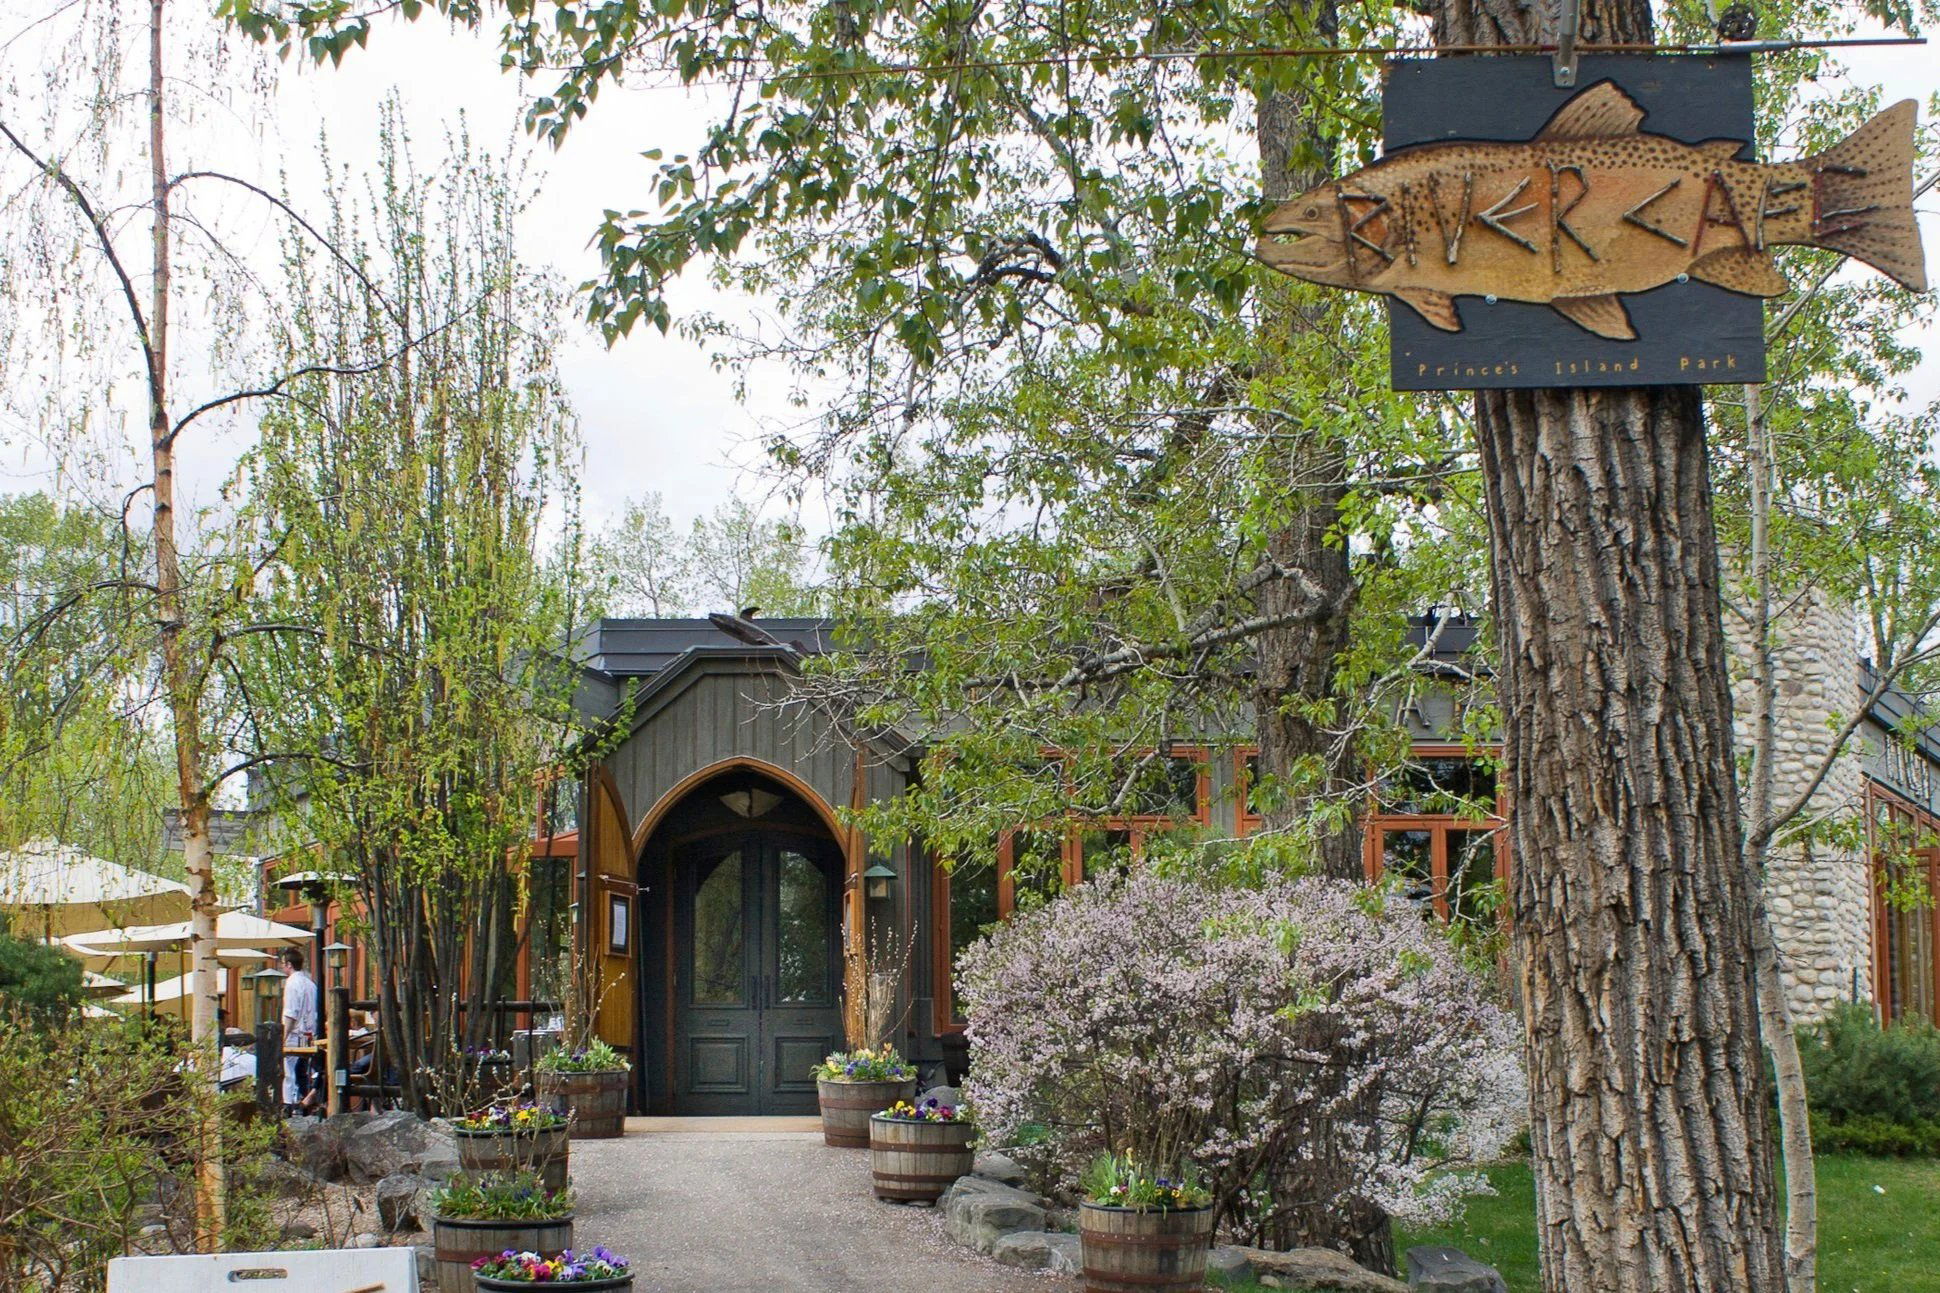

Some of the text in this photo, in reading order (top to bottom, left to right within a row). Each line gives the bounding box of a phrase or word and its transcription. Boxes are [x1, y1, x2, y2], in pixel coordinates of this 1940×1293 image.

[1336, 158, 1879, 278] RIVER CAFE
[1418, 354, 1737, 376] Prince's Island Park
